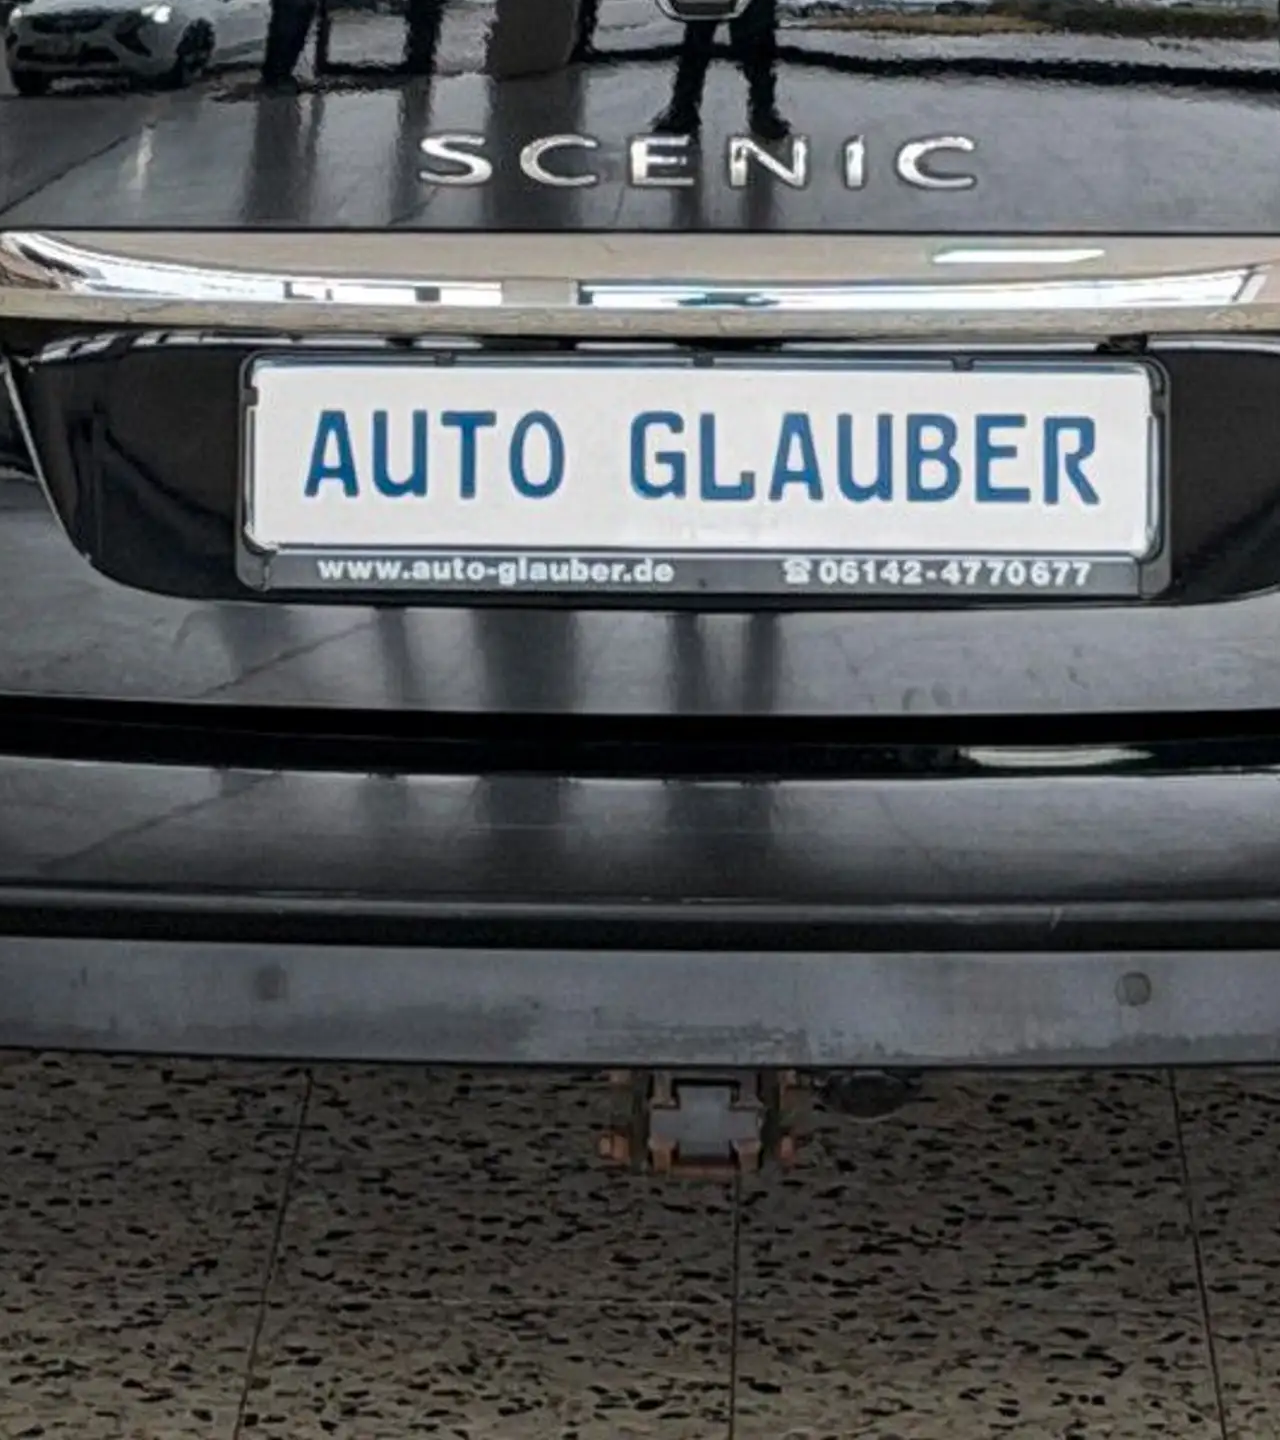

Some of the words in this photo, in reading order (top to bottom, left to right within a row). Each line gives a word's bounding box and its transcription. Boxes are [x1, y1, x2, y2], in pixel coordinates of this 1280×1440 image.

[420, 134, 976, 187] SCENIC
[304, 409, 566, 499] AUTO
[629, 410, 1100, 505] GLAUBER
[317, 559, 675, 585] www.auto-glauber.de
[819, 561, 1090, 586] 06142-4770677
